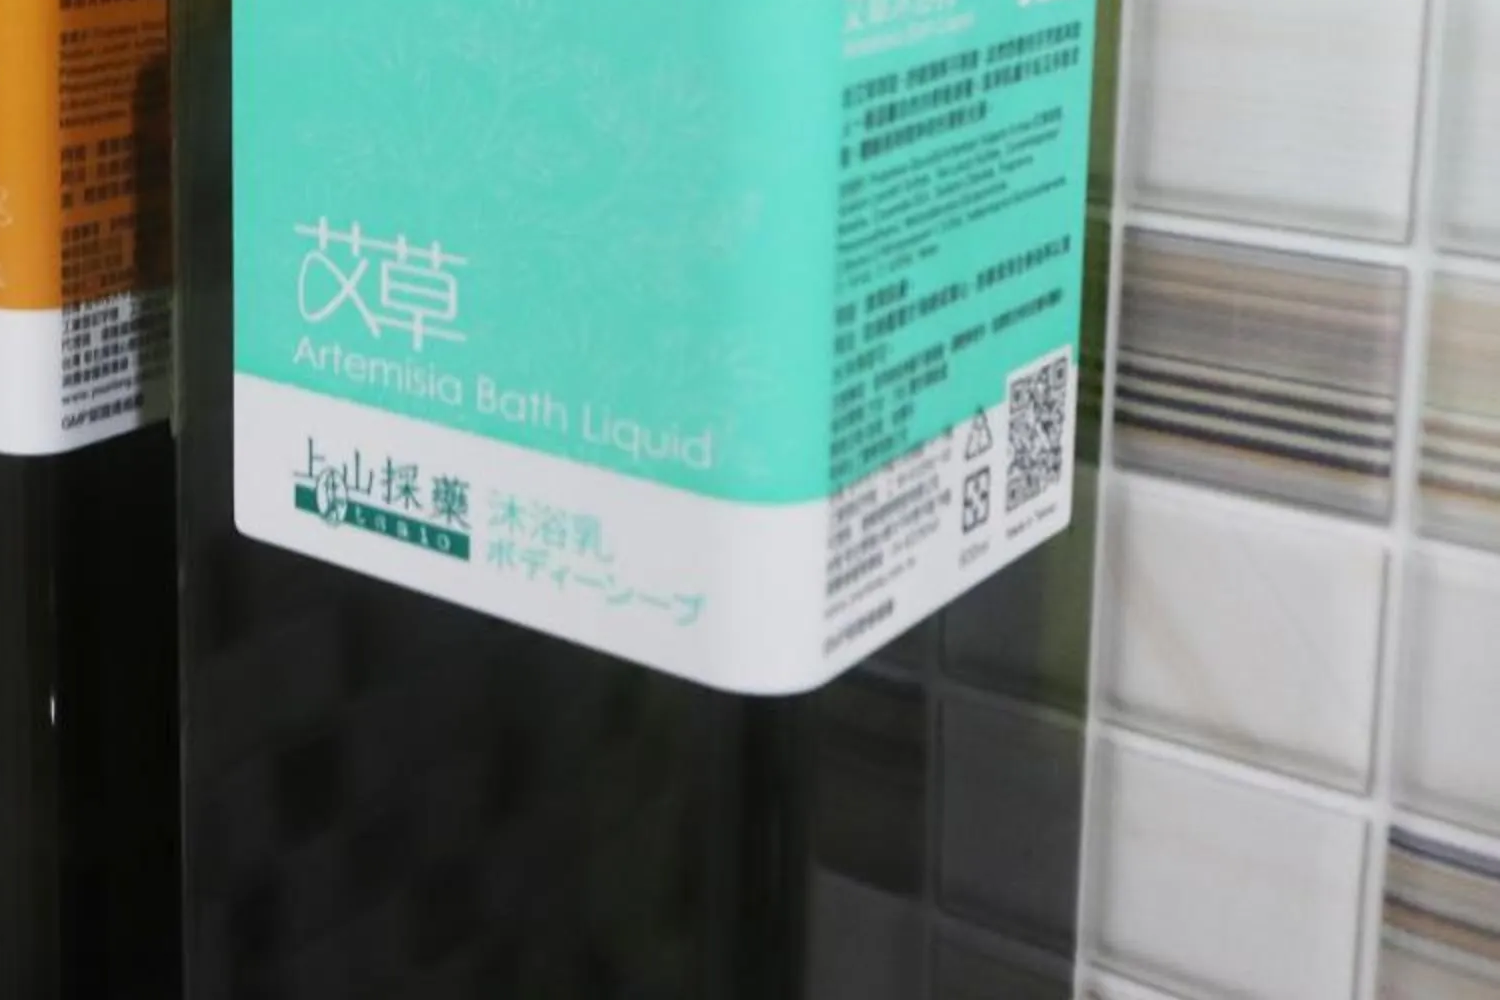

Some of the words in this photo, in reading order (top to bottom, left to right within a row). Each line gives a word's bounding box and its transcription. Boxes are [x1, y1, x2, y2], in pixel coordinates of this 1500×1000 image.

[294, 215, 468, 353] 艾草
[293, 335, 463, 405] Artemisia
[476, 374, 569, 432] Bath
[581, 405, 715, 470] Liquid
[488, 488, 615, 563] 沐浴乳
